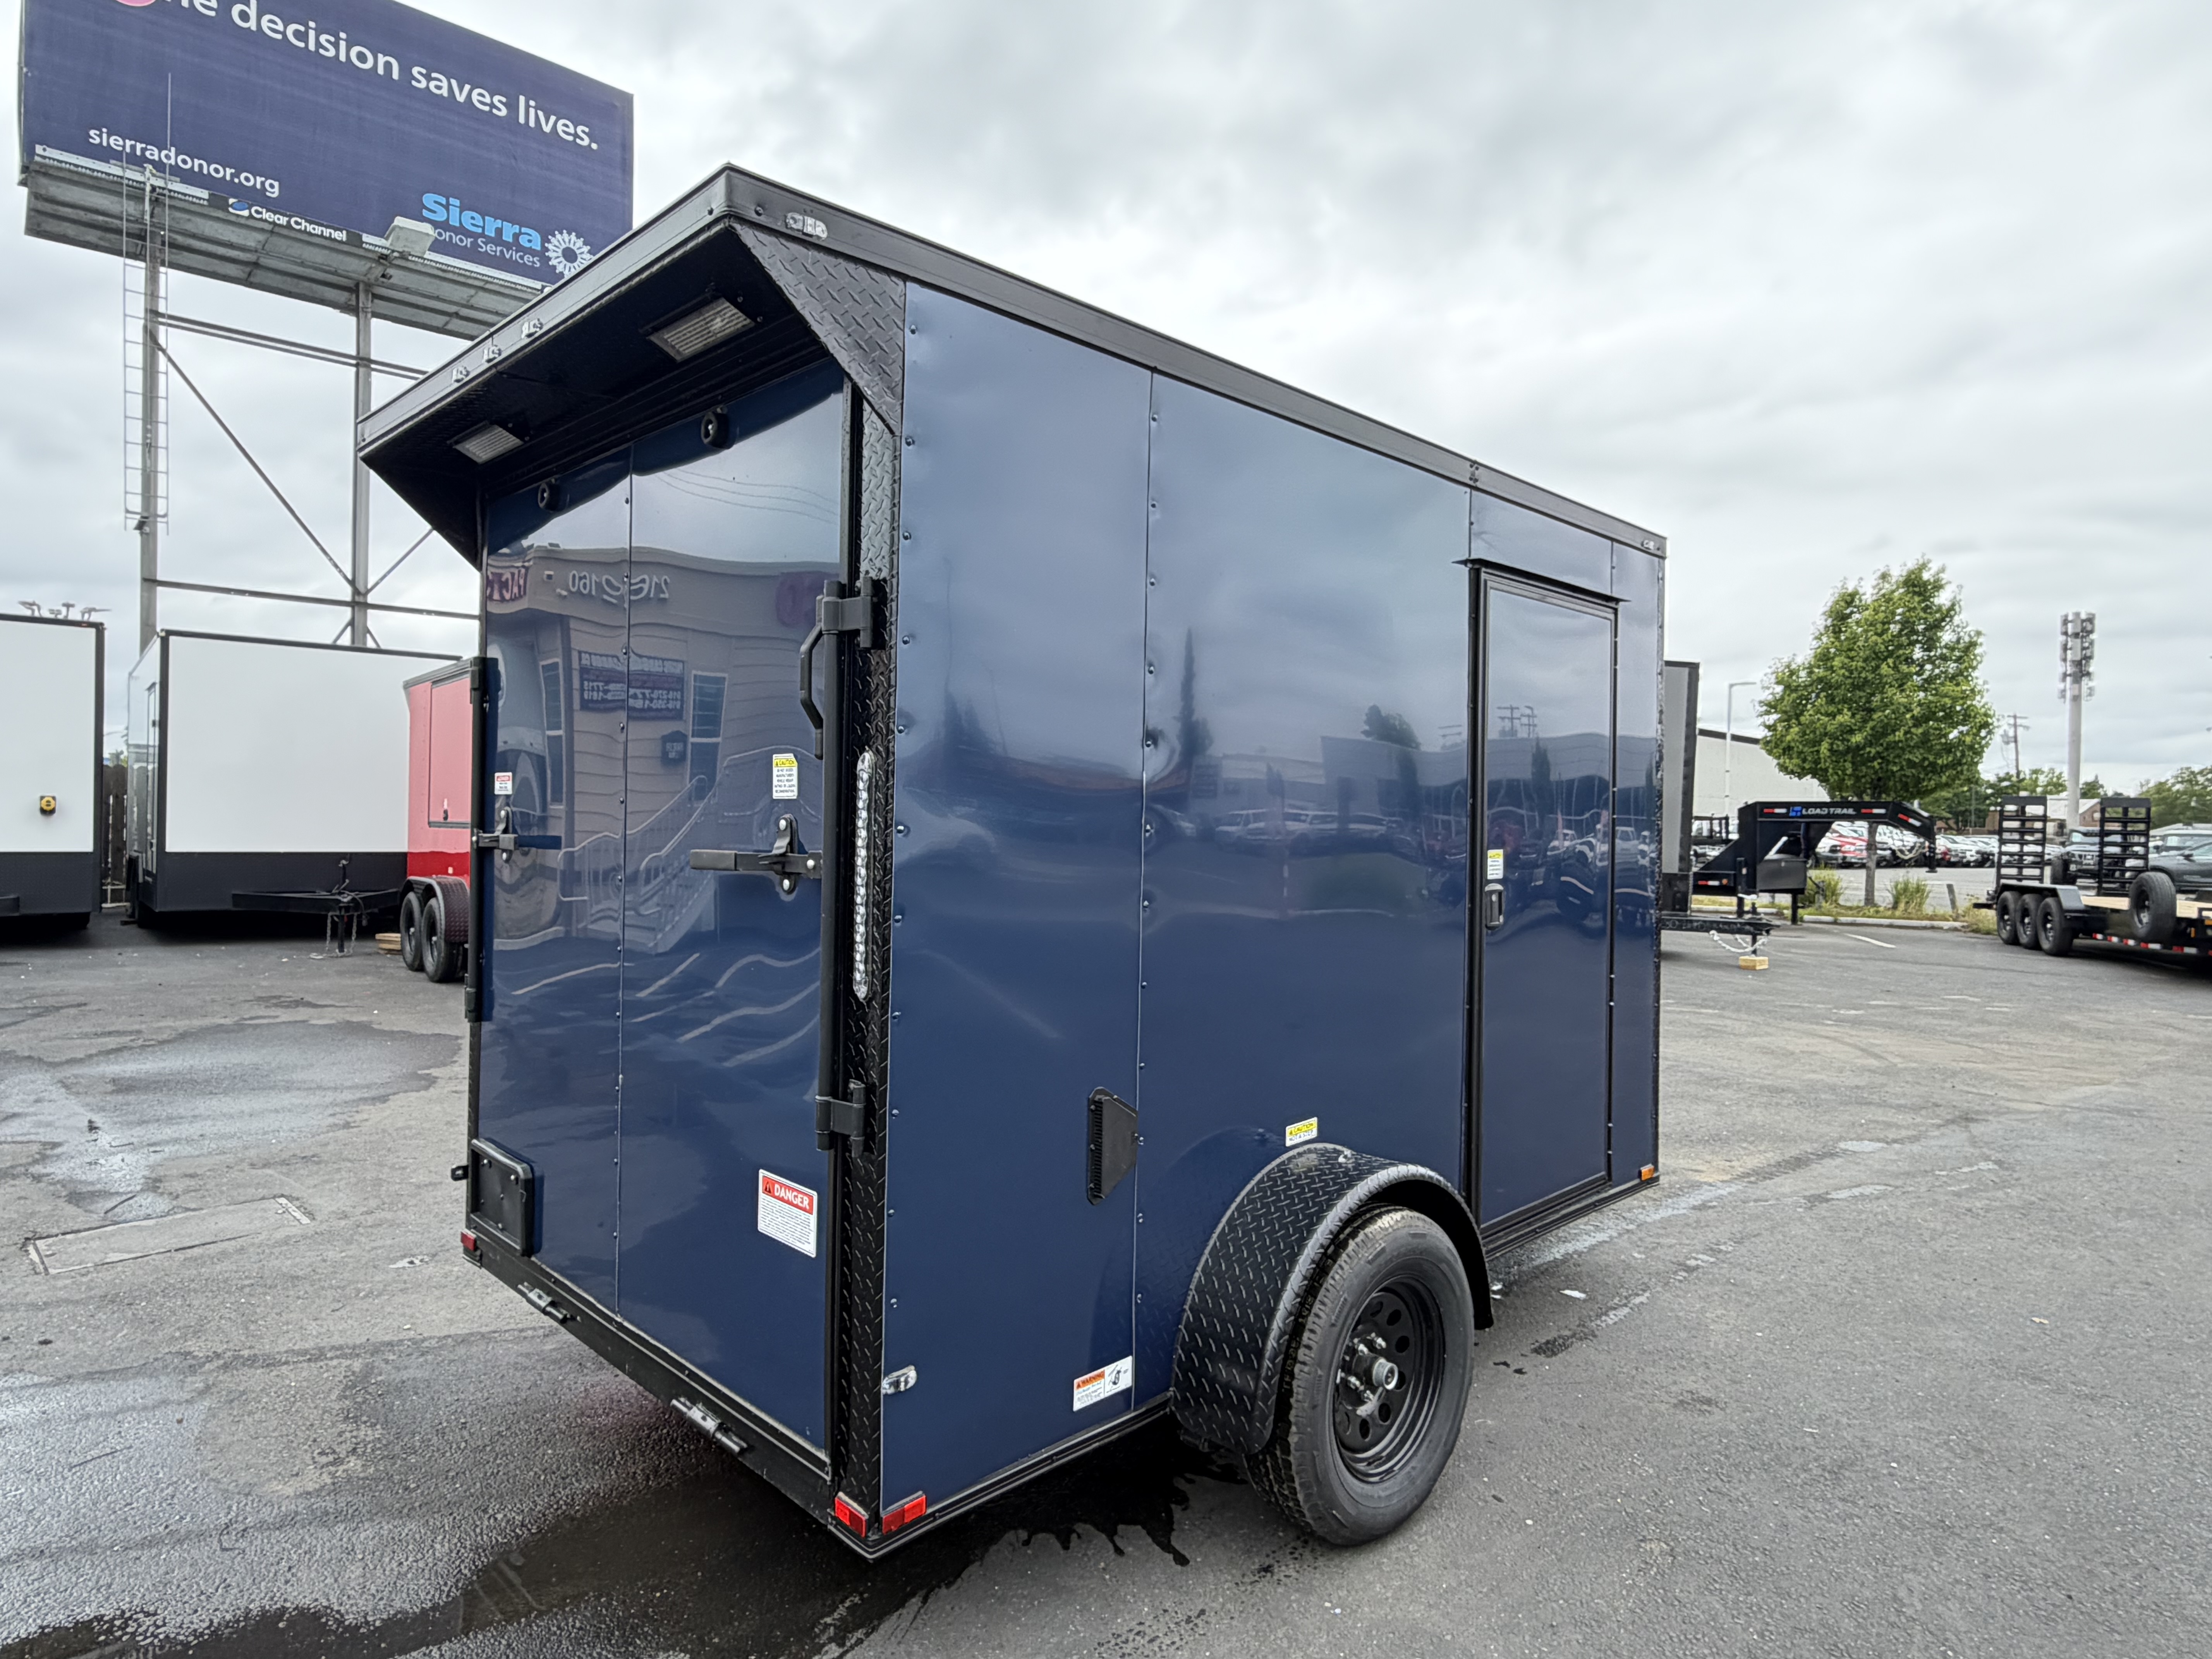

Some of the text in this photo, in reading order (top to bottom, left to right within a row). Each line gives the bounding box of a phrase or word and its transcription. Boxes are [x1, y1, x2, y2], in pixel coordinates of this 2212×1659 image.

[231, 0, 399, 80] decision
[411, 65, 507, 117] saves
[518, 94, 598, 150] lives.
[88, 127, 280, 198] sierradonor.org
[251, 206, 347, 242] Clear Channel
[422, 193, 541, 251] Sierra
[433, 228, 540, 267] onor Services
[774, 1183, 809, 1210] DANGER
